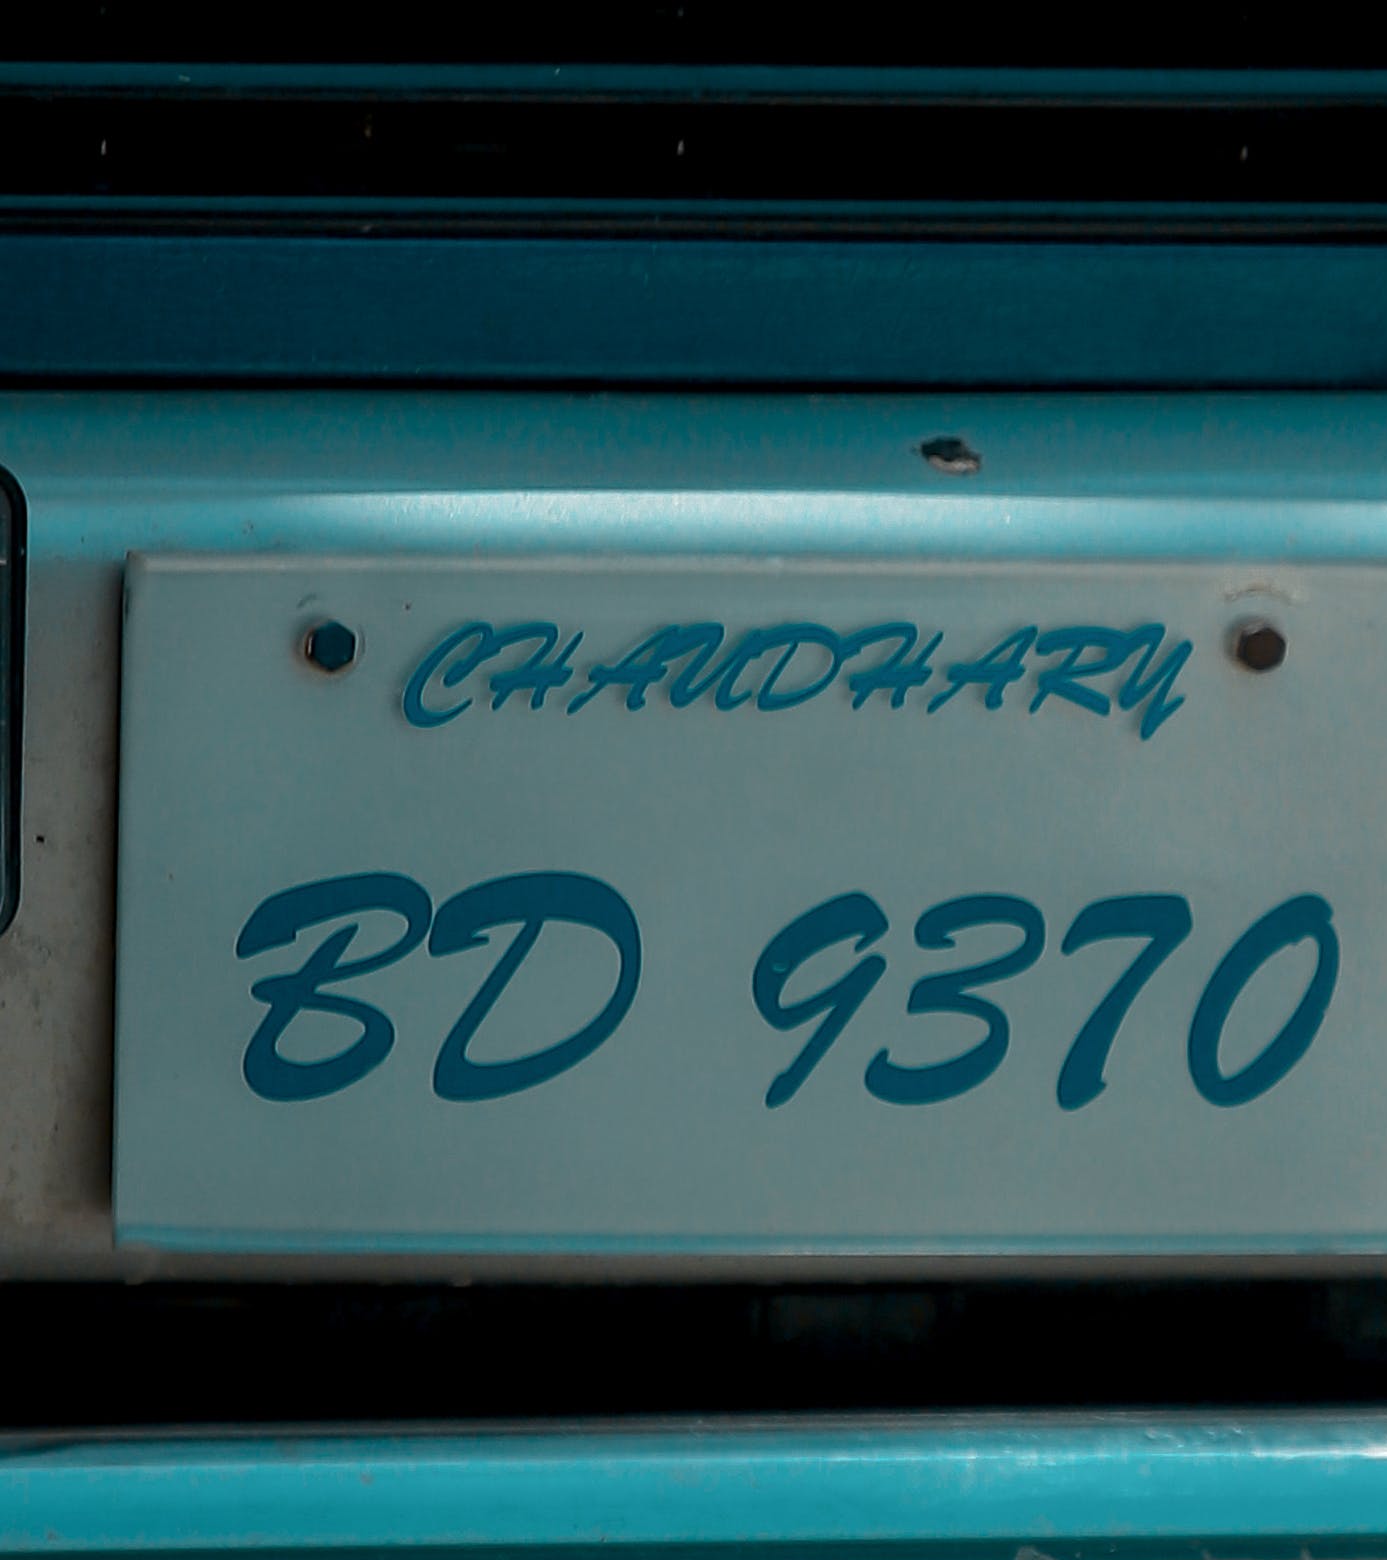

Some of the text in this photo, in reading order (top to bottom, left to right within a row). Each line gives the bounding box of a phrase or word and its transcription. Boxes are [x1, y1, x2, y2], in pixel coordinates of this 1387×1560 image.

[403, 619, 1193, 741] CHAUDHARY
[235, 870, 1340, 1111] BD 9370
